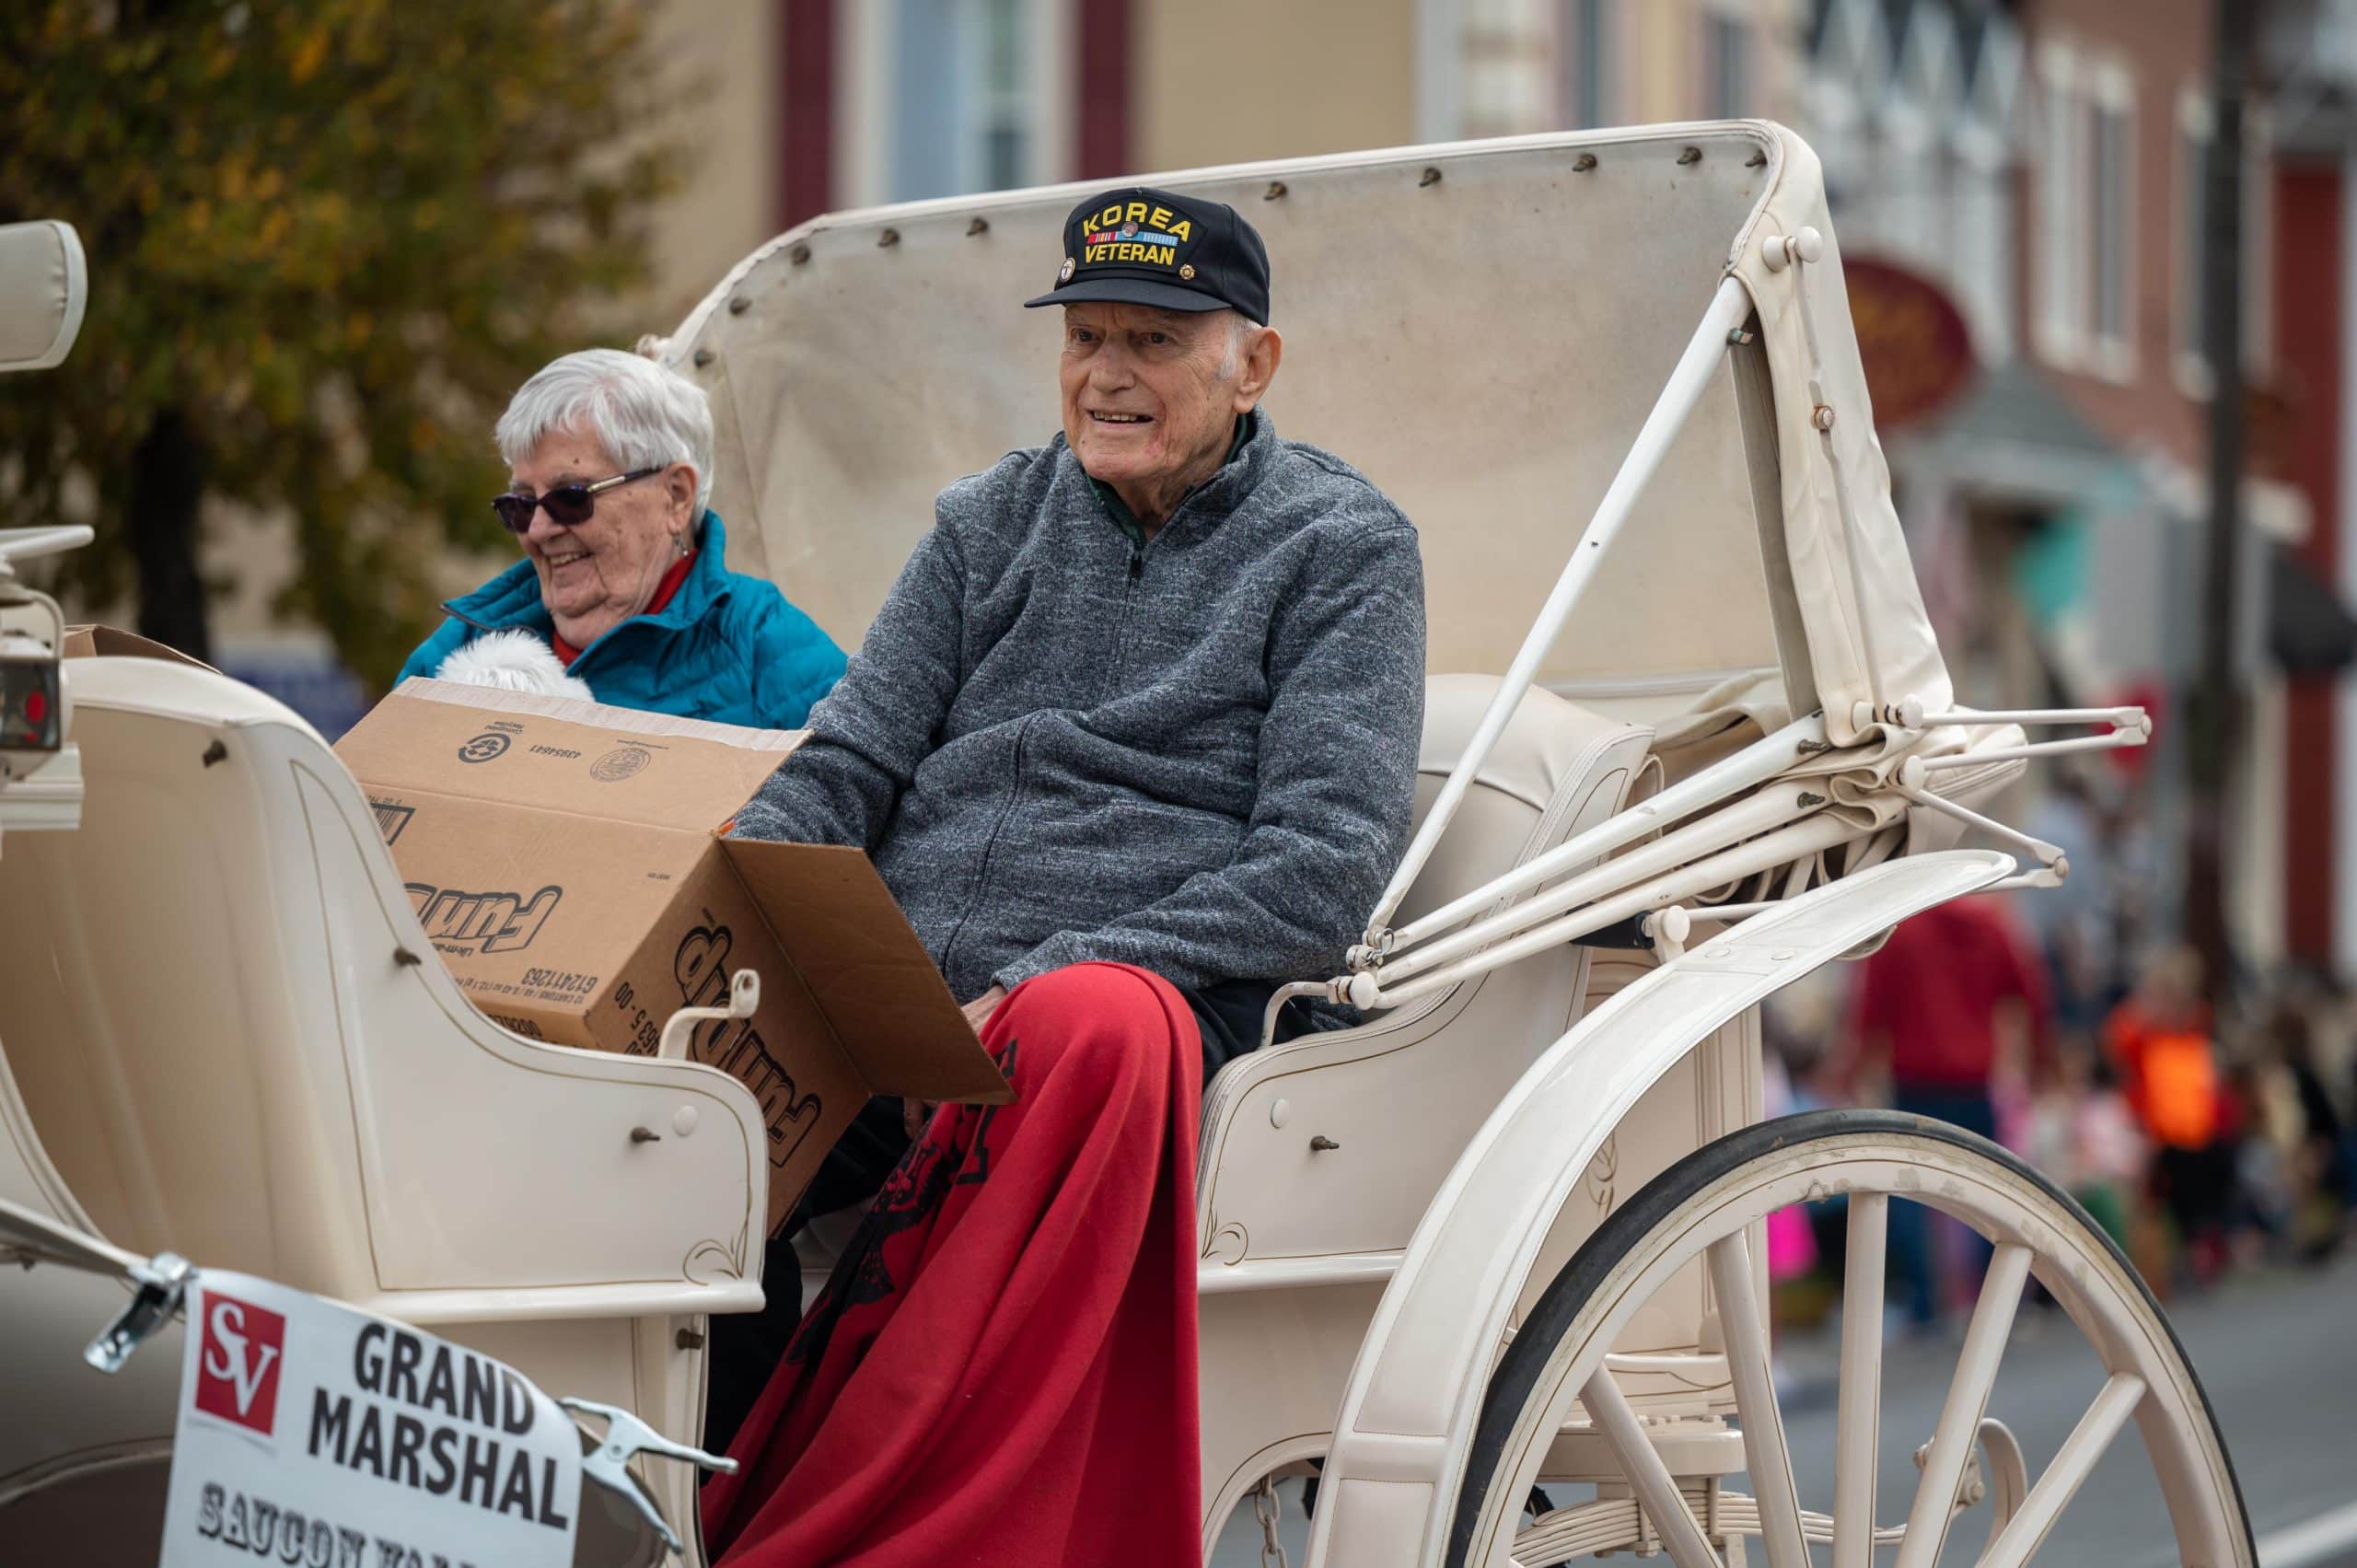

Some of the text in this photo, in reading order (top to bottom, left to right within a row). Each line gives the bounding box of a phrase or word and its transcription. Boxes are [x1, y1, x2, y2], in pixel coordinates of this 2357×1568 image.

[1083, 202, 1192, 242] KOREA
[1085, 243, 1176, 266] VETERAN
[204, 1302, 279, 1417] SV
[354, 1322, 536, 1436] GRAND
[308, 1388, 569, 1531] MARSHAL
[197, 1481, 366, 1568] SAUCON
